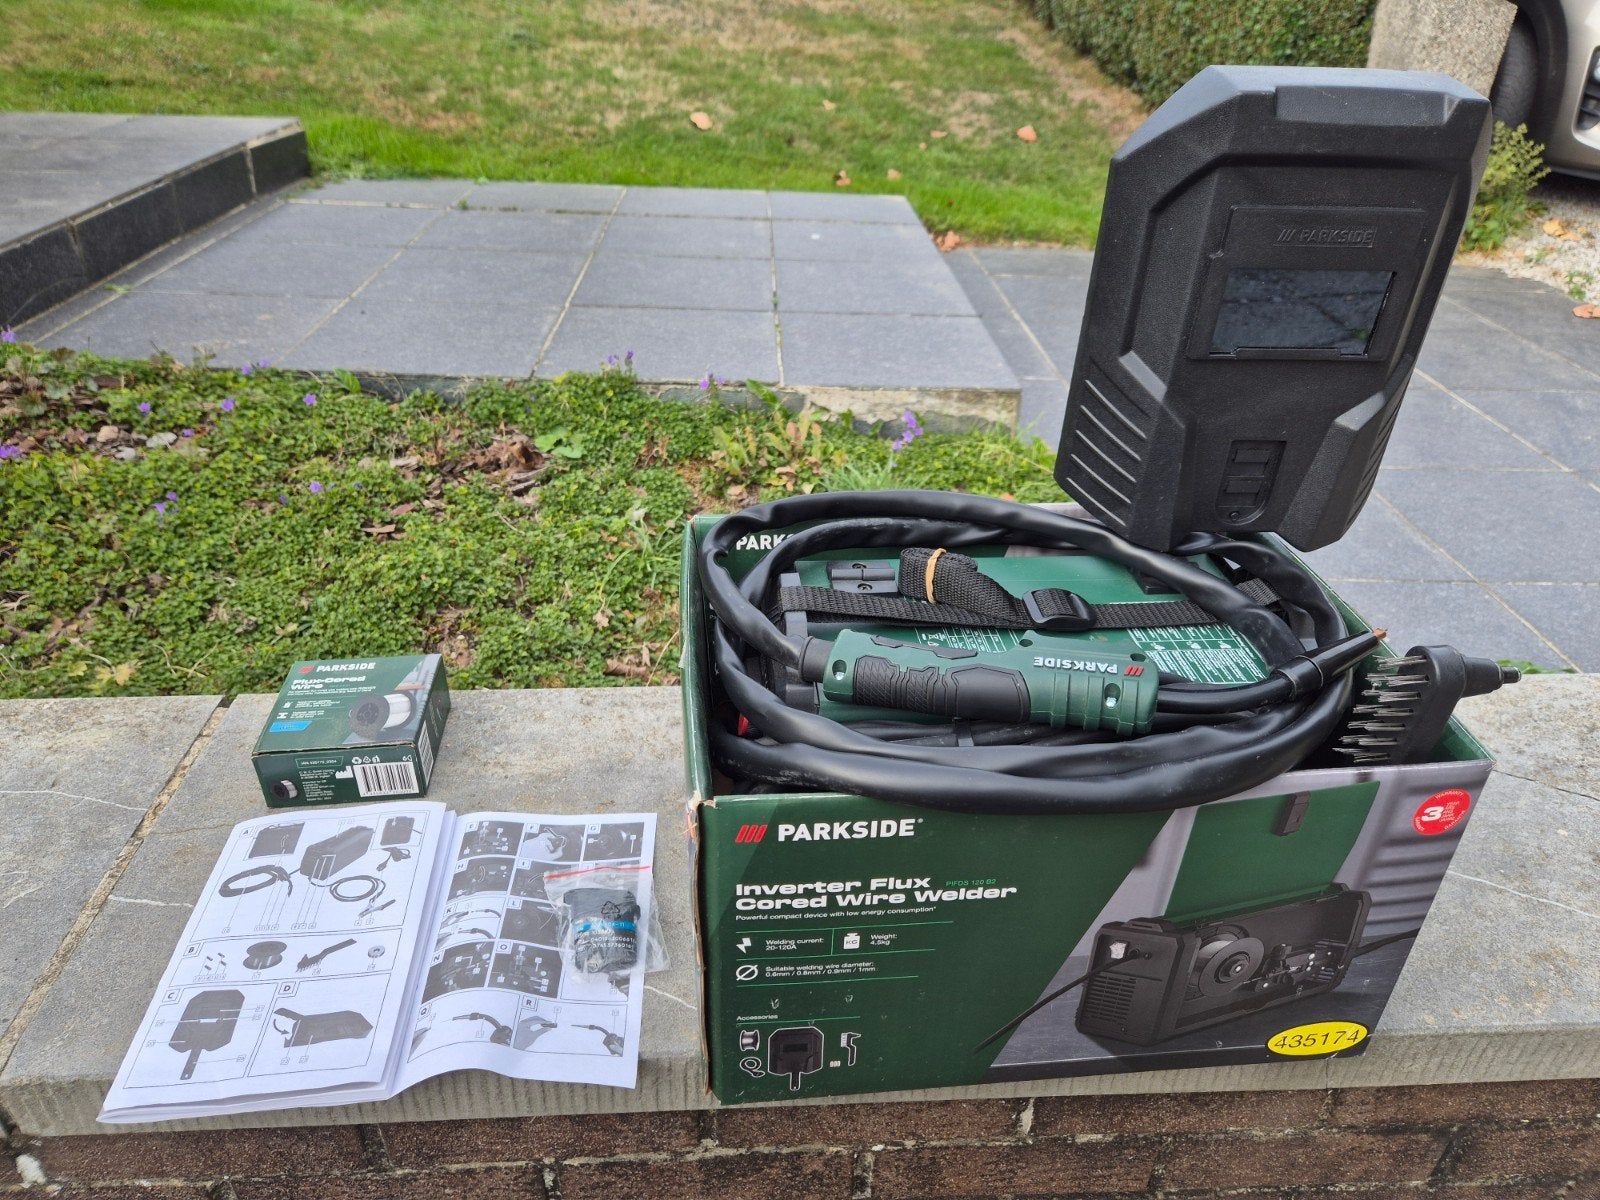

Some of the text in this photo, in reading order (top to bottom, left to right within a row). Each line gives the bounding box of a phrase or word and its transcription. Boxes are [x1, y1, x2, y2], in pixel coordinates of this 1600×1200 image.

[1300, 229, 1376, 242] PARKSIDE
[736, 533, 794, 550] PARK
[316, 662, 376, 673] PARKSIDE
[1033, 656, 1118, 674] PARKSIDE
[1421, 805, 1444, 822] 3
[778, 818, 915, 842] PARKSIDE
[736, 877, 931, 896] Inverter Flux
[736, 887, 1017, 911] Cored Wire Welder
[1274, 1029, 1360, 1049] 435174
